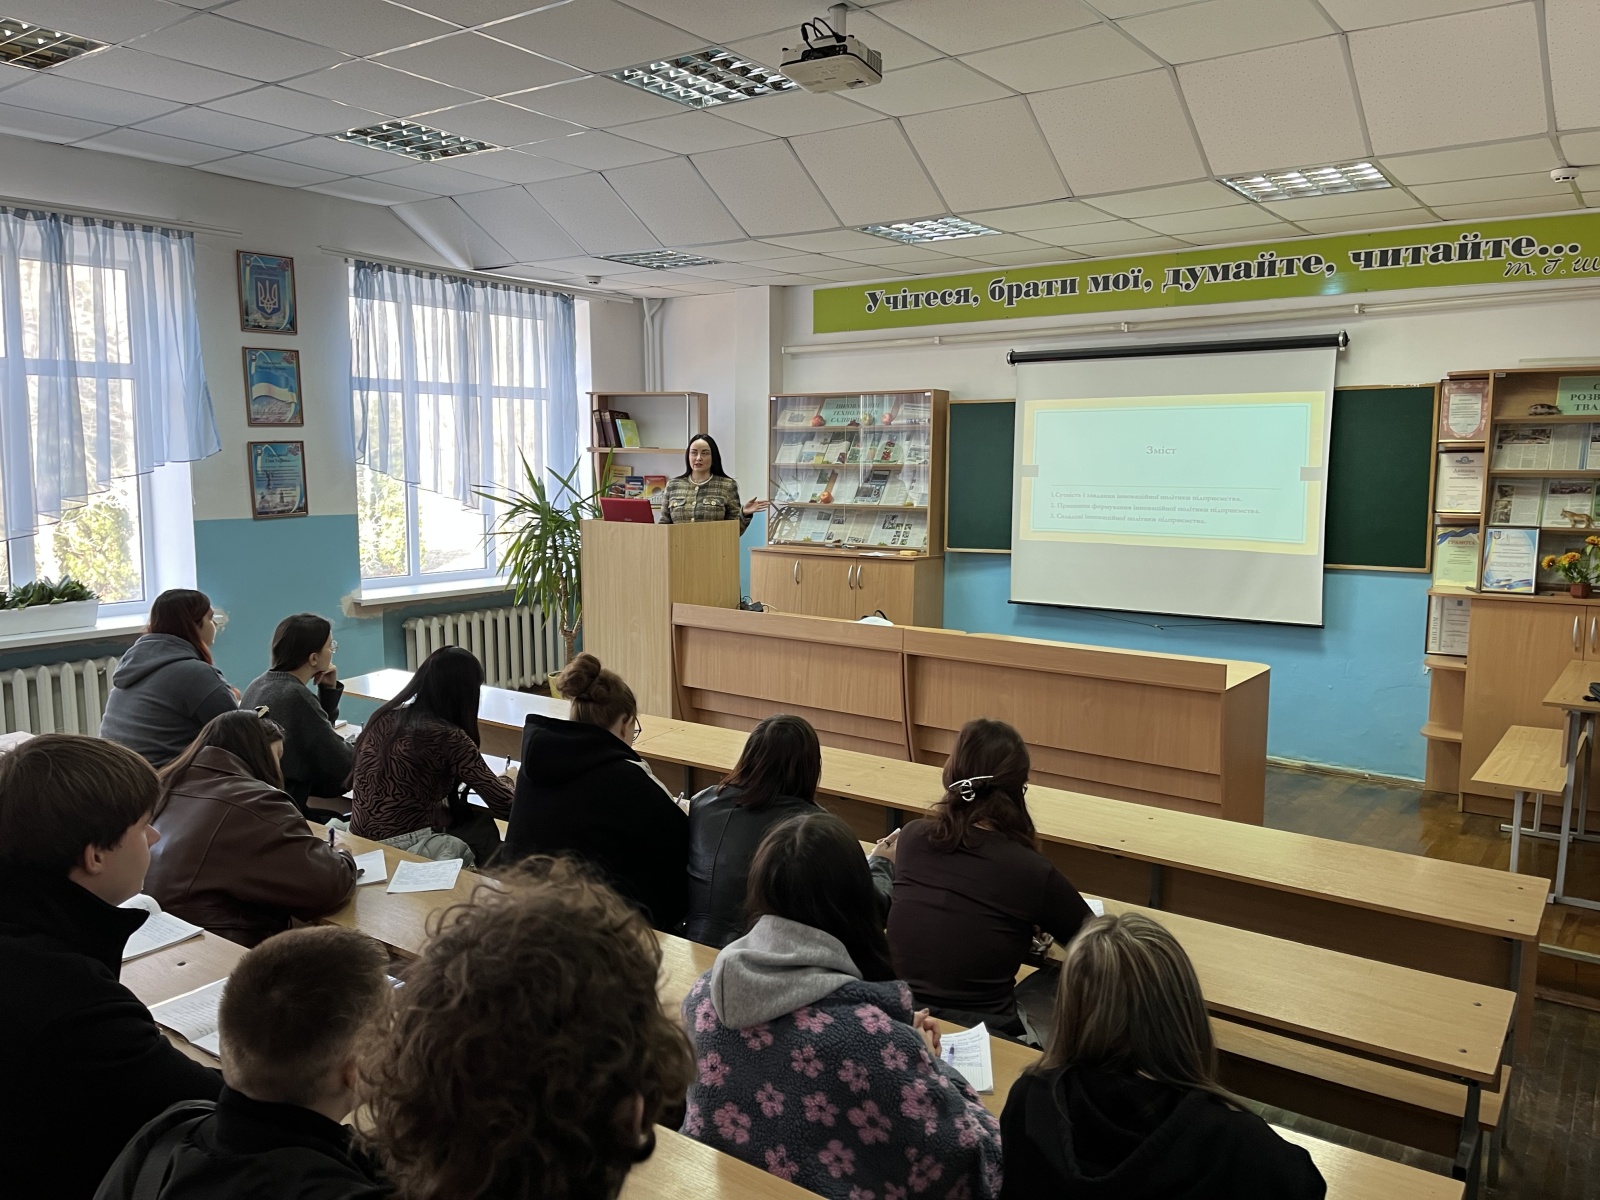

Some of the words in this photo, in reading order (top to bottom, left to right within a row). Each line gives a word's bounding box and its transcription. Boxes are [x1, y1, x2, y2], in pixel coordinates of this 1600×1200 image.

[865, 287, 980, 313] Учітеся,
[988, 277, 1079, 307] брати
[1087, 268, 1153, 293] мої,
[1162, 251, 1336, 293] думайте,
[1349, 232, 1581, 271] читайте...
[1573, 403, 1600, 411] ТВА
[1146, 445, 1177, 456] Зміст
